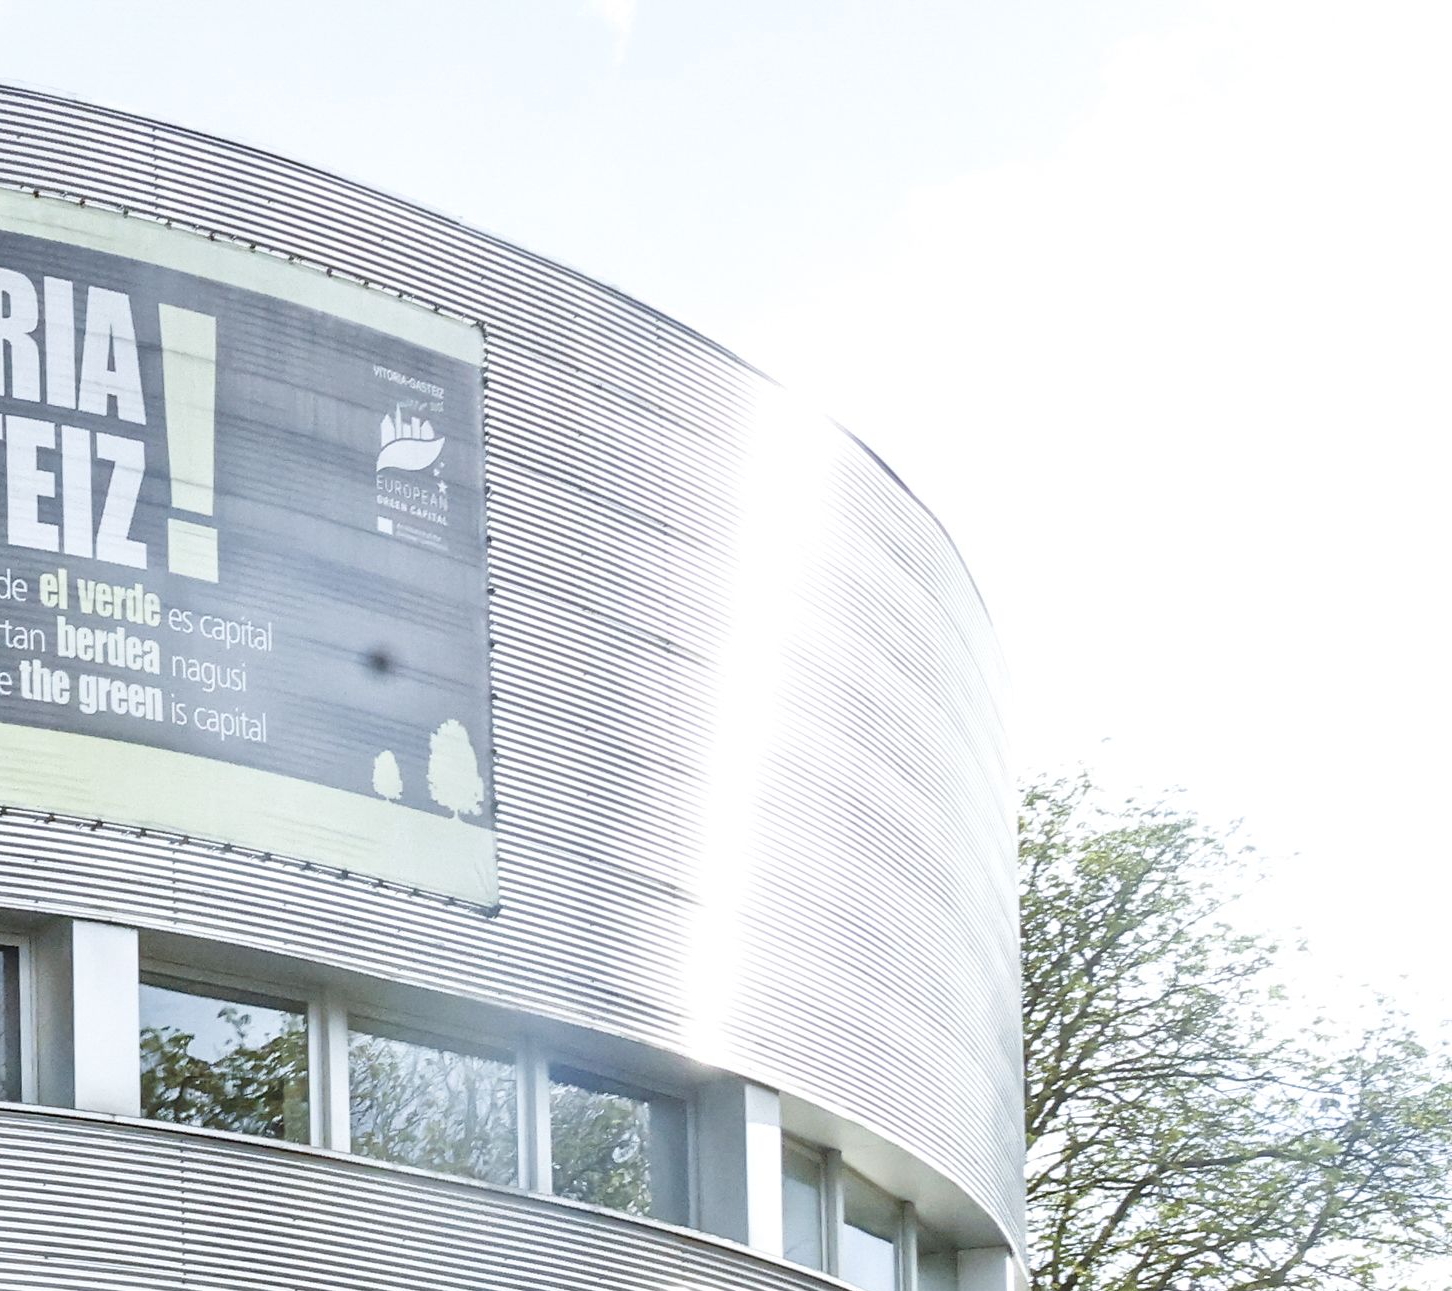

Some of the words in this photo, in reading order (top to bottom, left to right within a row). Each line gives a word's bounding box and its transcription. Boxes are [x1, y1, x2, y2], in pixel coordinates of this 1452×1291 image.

[376, 474, 448, 512] EUROPEAN
[39, 567, 69, 611] el
[77, 577, 162, 628] verde
[168, 607, 194, 634] es
[200, 613, 273, 653] capital
[56, 615, 161, 676] berdea
[171, 654, 247, 693] nagusi
[18, 658, 70, 706] the
[78, 672, 164, 723] green
[172, 693, 188, 726] is
[194, 706, 268, 744] capital
